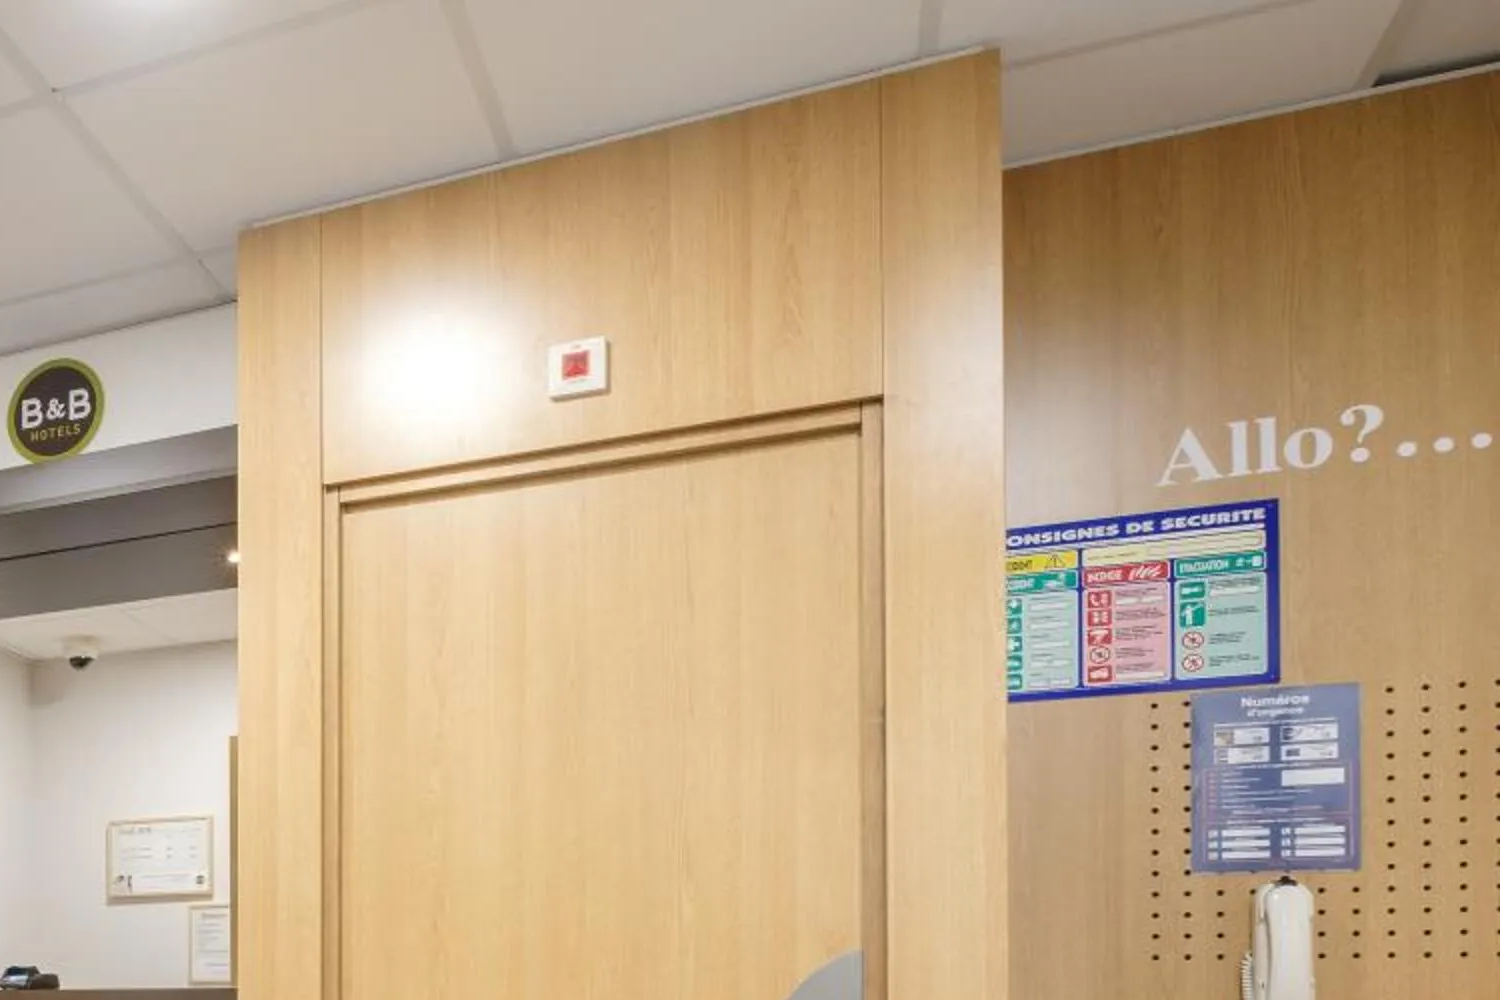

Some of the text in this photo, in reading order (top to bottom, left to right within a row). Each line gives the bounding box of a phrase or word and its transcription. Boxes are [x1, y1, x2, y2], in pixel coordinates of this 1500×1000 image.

[21, 388, 91, 430] B&B
[30, 423, 81, 441] HOTELS
[1007, 522, 1120, 547] ONSIGNES
[1125, 520, 1155, 535] DE
